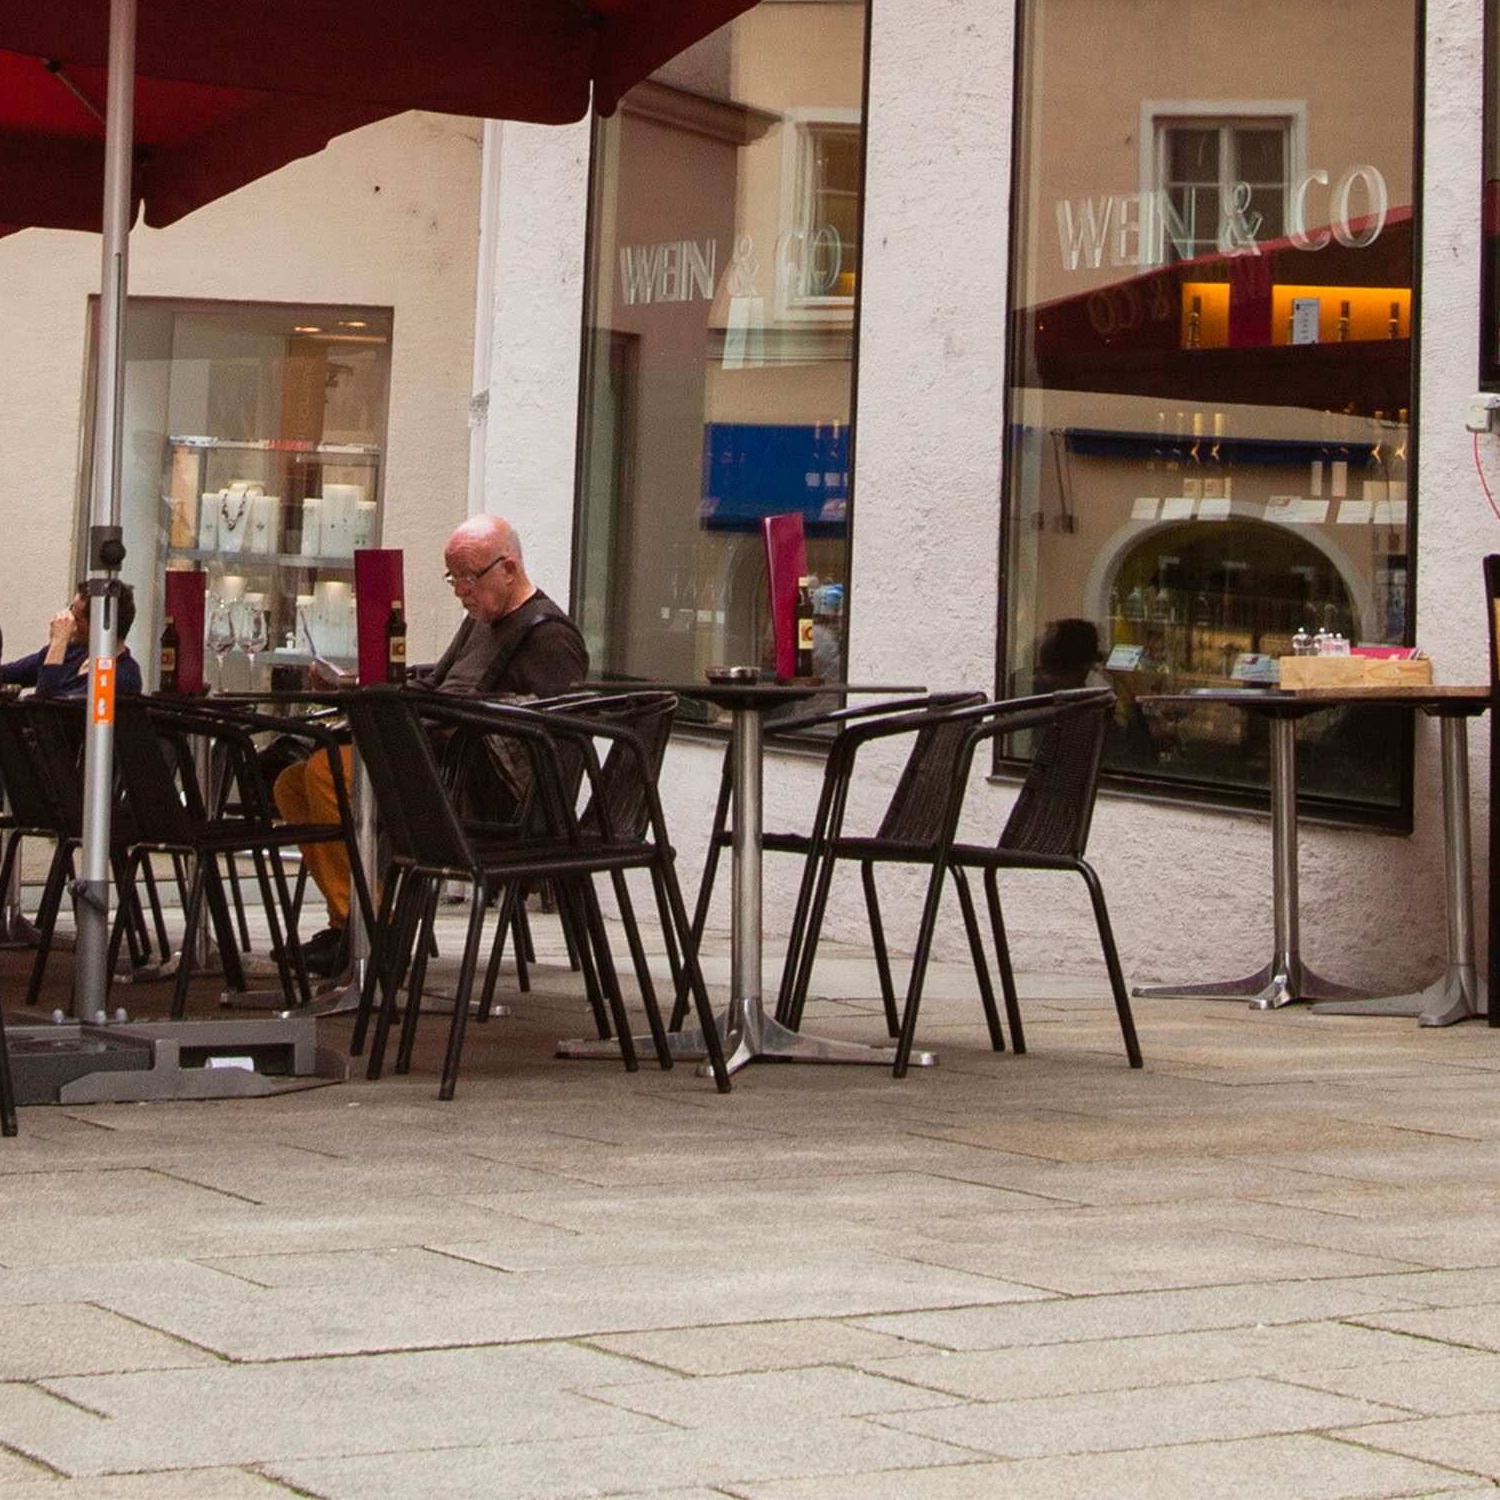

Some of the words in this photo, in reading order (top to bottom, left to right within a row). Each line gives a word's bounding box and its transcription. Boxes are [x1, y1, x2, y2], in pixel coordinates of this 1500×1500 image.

[1055, 186, 1197, 271] WEIN
[1218, 180, 1263, 258] &
[1285, 164, 1388, 251] CO
[726, 234, 760, 298] &
